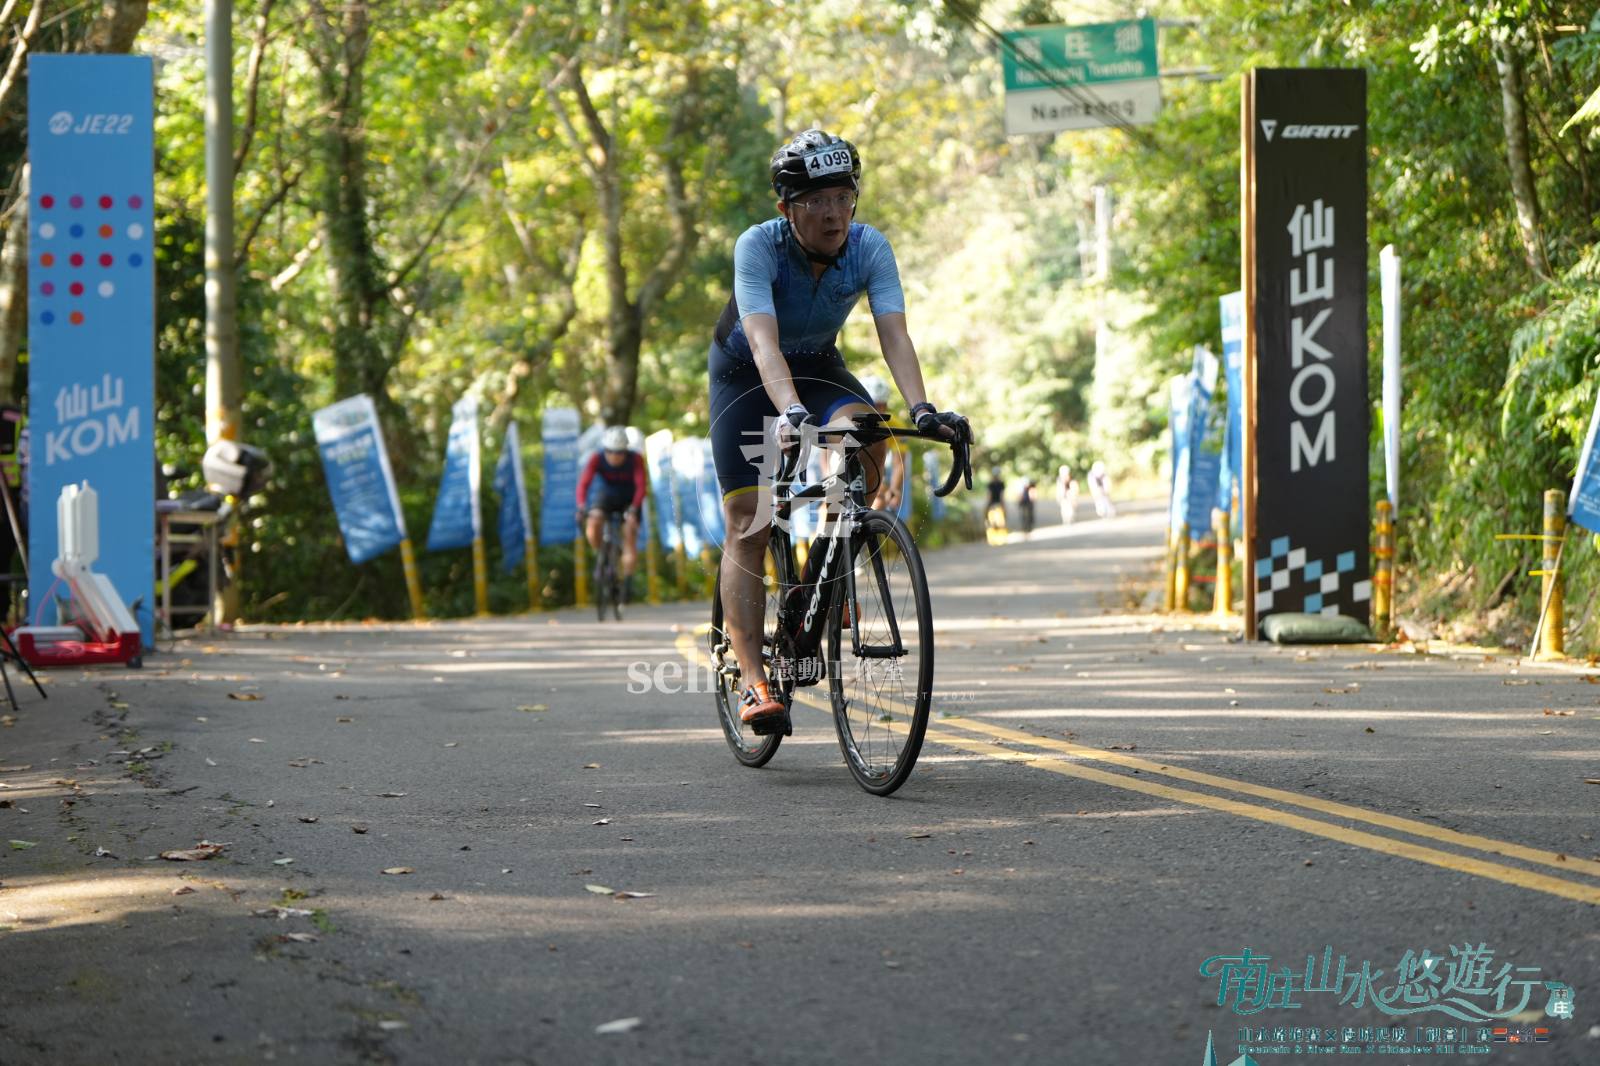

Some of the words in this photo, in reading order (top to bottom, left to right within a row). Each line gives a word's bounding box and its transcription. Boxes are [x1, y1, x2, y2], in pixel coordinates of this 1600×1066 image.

[74, 113, 134, 135] JE22
[1281, 124, 1360, 139] GIANT
[1287, 198, 1336, 307] 仙山
[55, 373, 124, 424] 仙山
[1289, 307, 1336, 473] KOM
[45, 406, 141, 466] KOM
